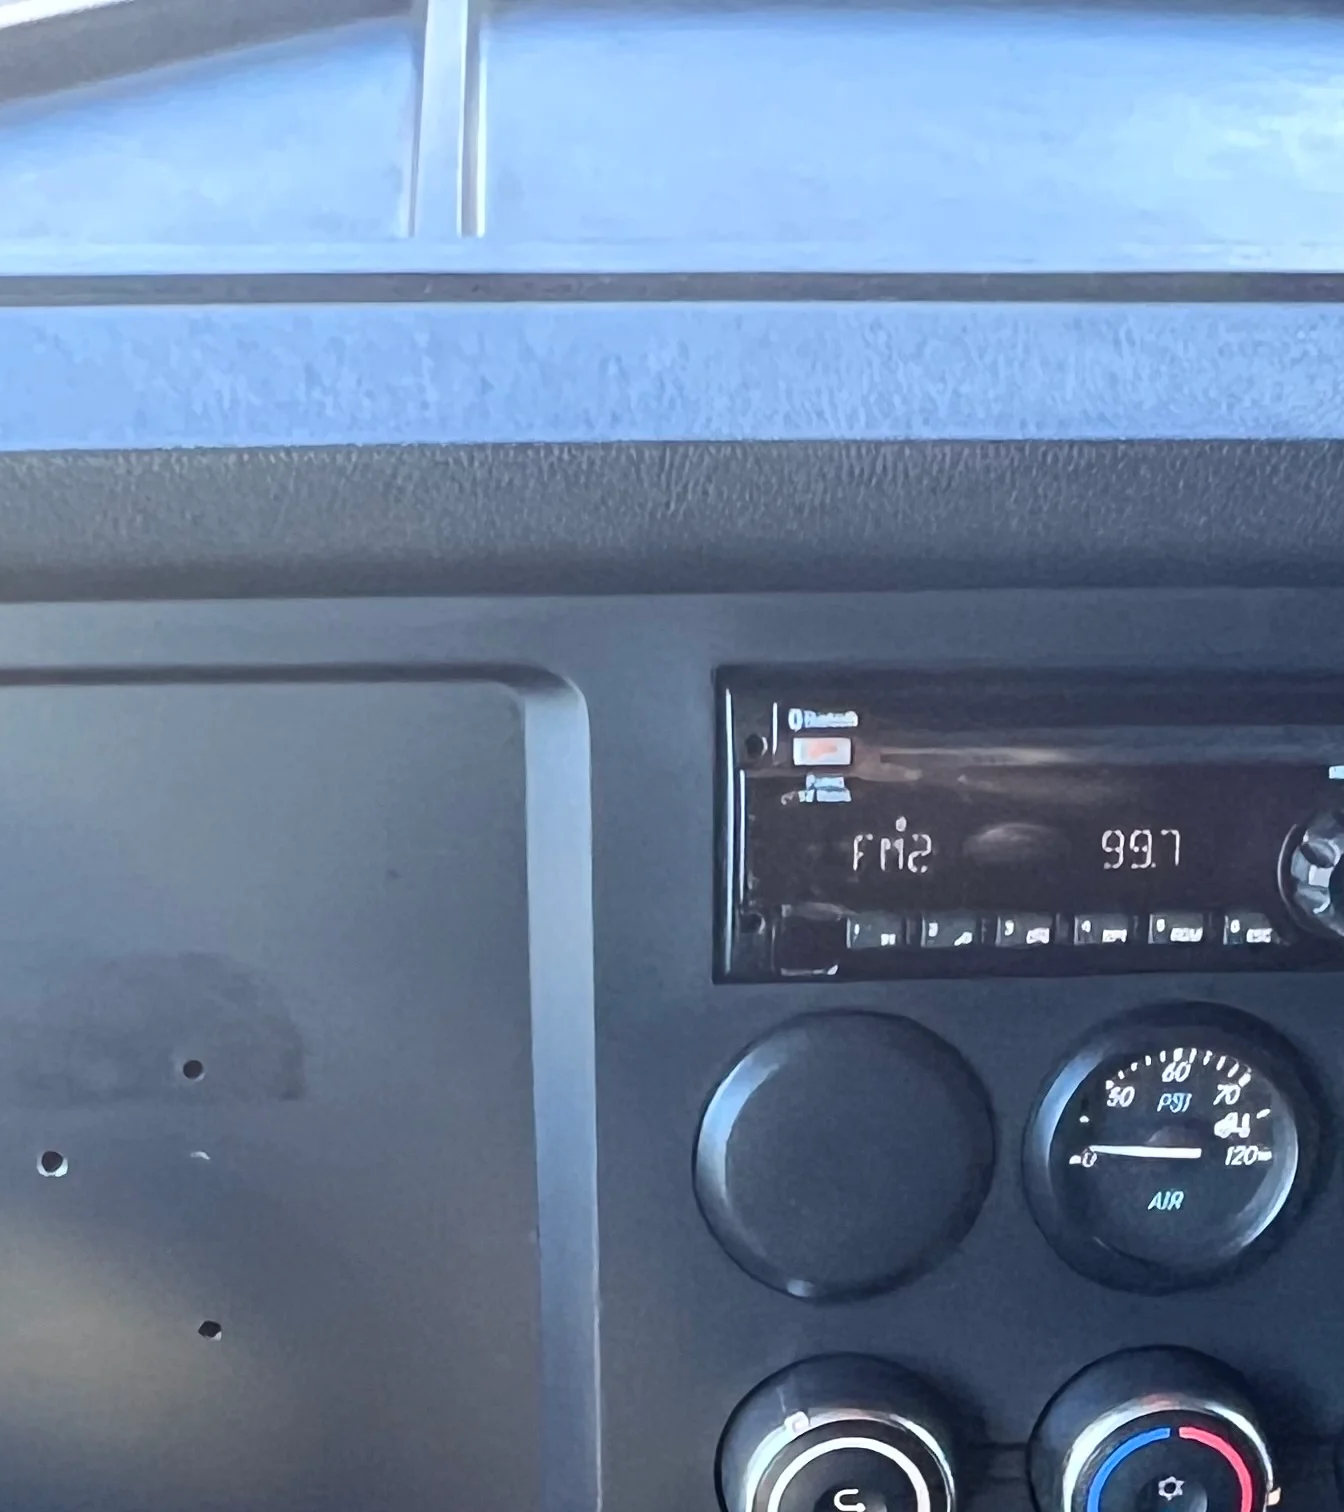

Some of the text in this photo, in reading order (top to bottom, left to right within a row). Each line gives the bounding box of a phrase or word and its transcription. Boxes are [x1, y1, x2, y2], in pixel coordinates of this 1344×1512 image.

[1161, 1061, 1193, 1084] 60
[1156, 1092, 1194, 1114] PSI
[1212, 1083, 1243, 1107] 70
[1224, 1145, 1260, 1167] 120
[1147, 1190, 1186, 1211] AIR
